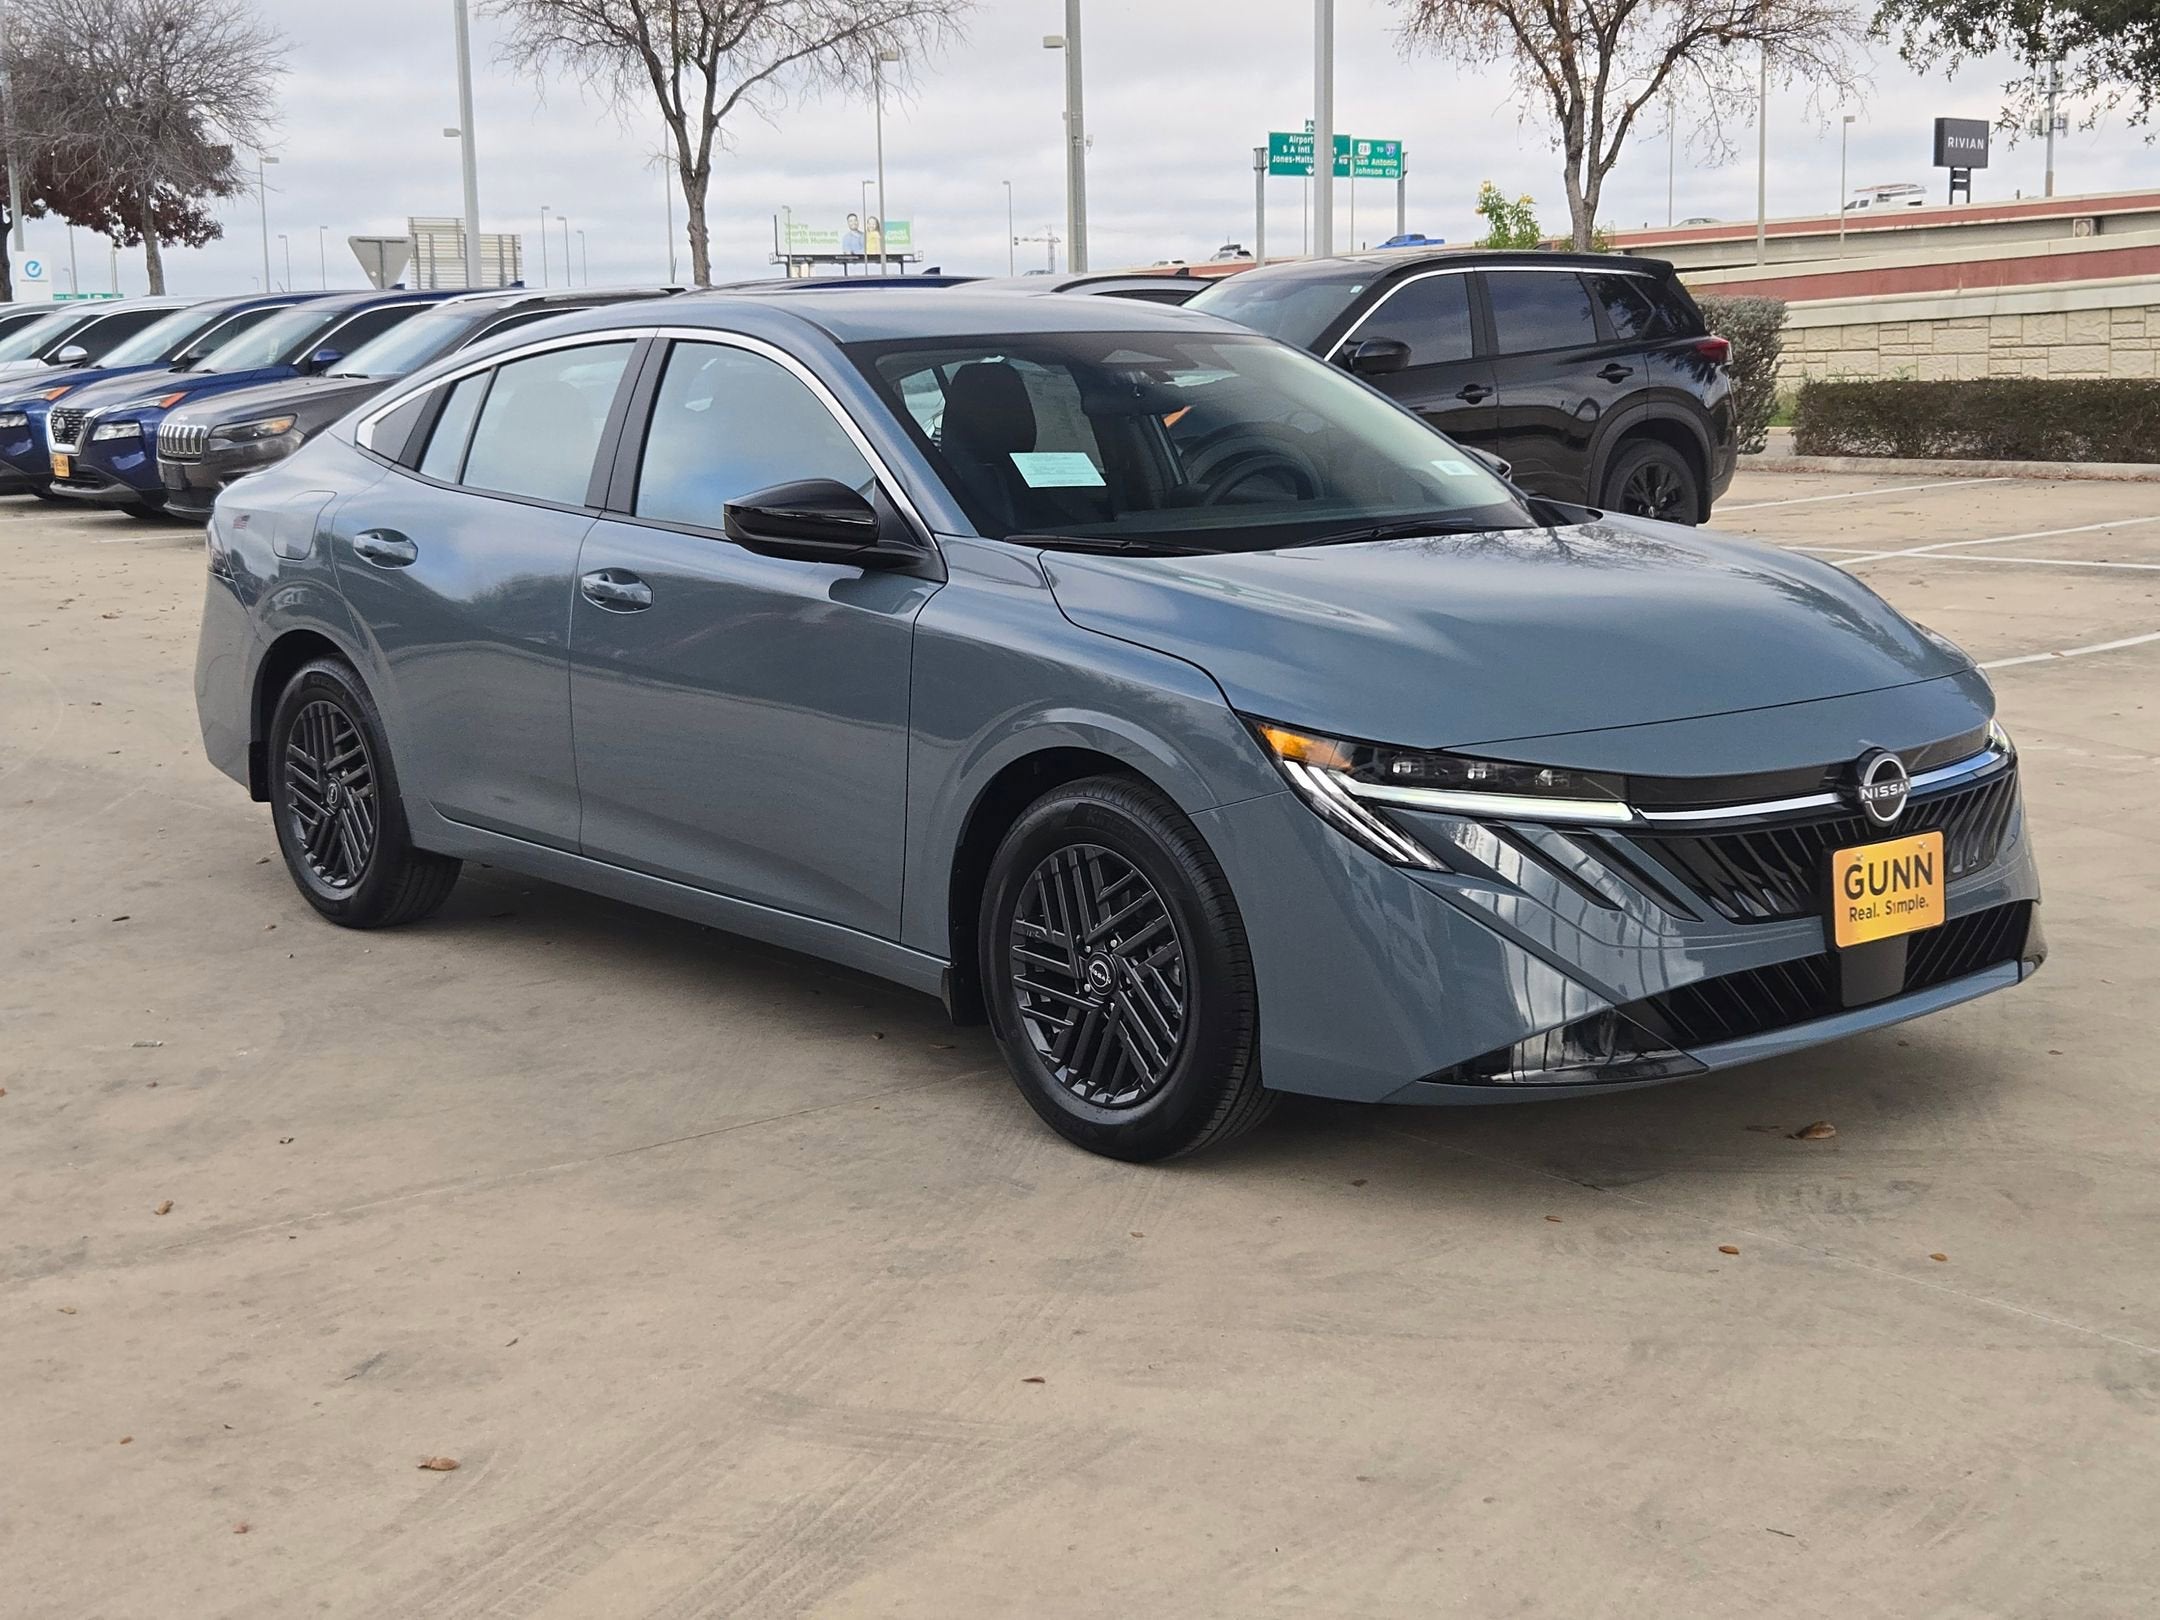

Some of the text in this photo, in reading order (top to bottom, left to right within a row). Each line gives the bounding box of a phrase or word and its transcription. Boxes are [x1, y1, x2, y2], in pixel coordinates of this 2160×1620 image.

[1289, 135, 1314, 145] Airport
[1947, 136, 1985, 150] RIVIAN
[1371, 158, 1398, 167] Antonio
[1355, 167, 1399, 177] Johnson City
[1861, 781, 1911, 800] NISSAN
[1844, 852, 1933, 900] GUNN
[1849, 894, 1929, 922] Real. Simple.
